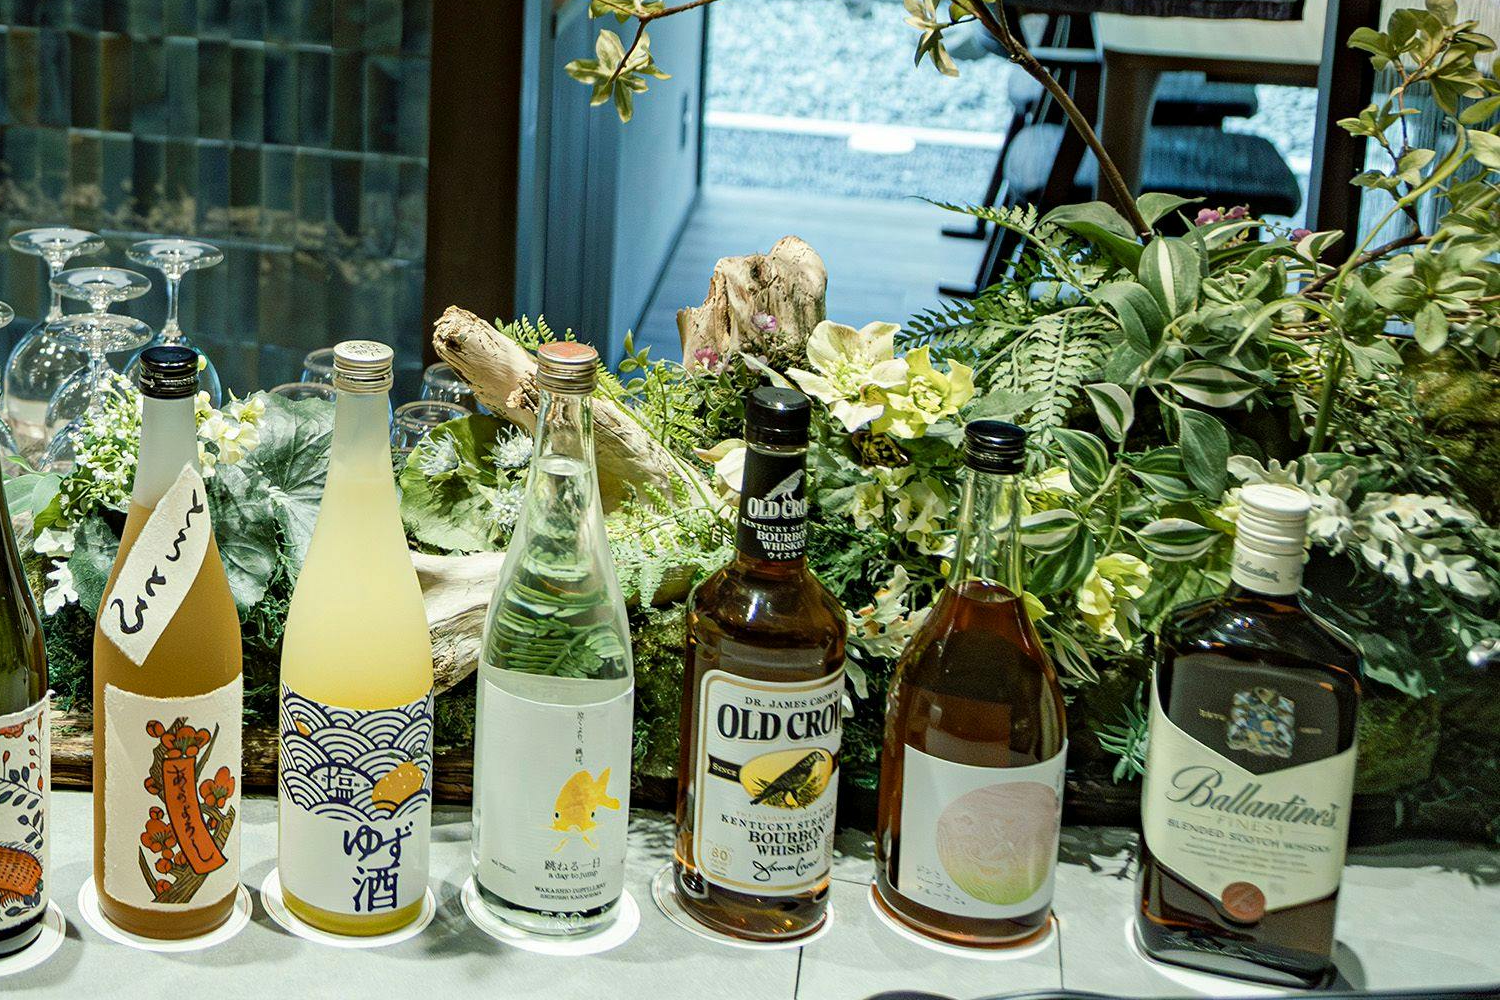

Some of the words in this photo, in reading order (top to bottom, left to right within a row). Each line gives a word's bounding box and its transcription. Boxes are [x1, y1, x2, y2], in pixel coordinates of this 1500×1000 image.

[747, 496, 780, 519] OLD
[741, 517, 789, 532] KENTUCKY
[745, 696, 765, 708] DR.
[769, 699, 807, 710] JAMES
[717, 703, 782, 741] OLD
[1165, 765, 1341, 829] Ballantine's
[721, 813, 793, 832] KENTUCKY
[1167, 817, 1225, 839] BLENDED
[1228, 831, 1280, 849] SCOTCH
[1217, 816, 1285, 837] FINEST
[748, 824, 826, 845] BOURBON
[756, 839, 821, 857] WHISKEY
